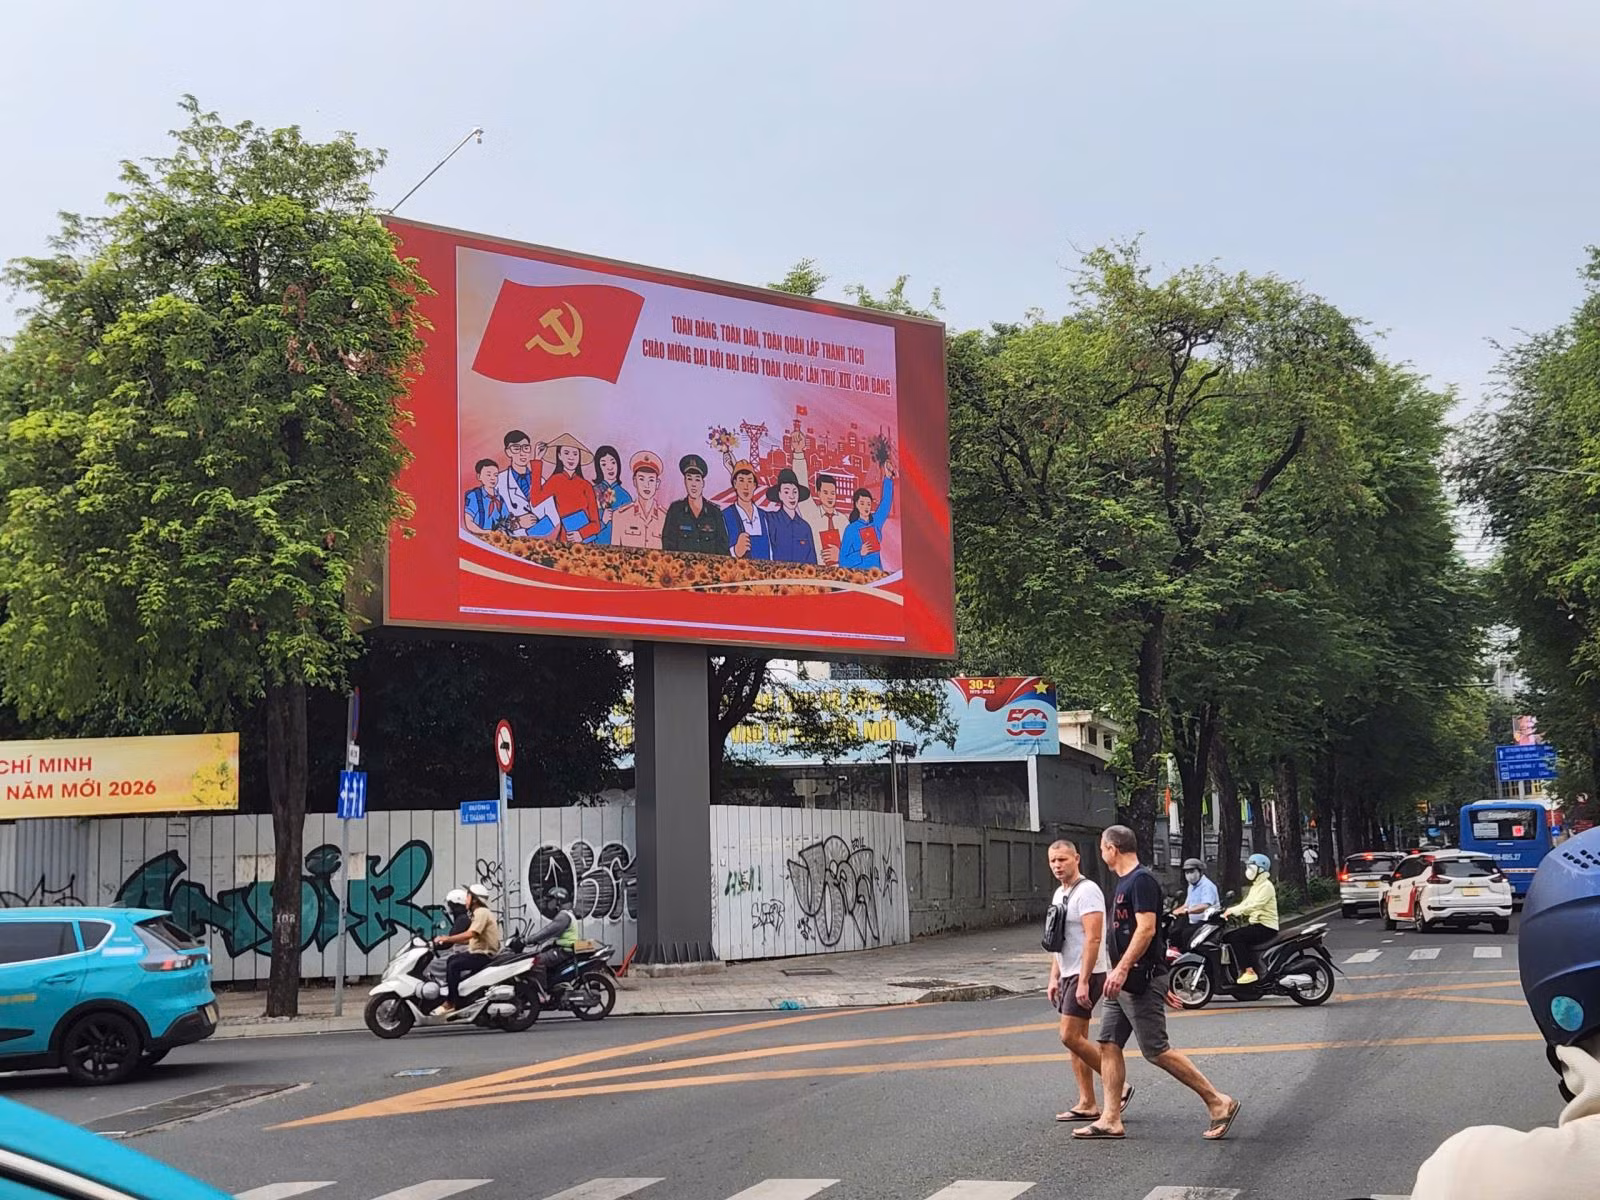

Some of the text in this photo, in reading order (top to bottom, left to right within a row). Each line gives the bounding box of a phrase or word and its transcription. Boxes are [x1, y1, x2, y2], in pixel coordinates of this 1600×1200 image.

[672, 314, 864, 365] TOÀN ĐẢNG, TOÀN DÂN, TOÀN QUÂN LẬP THÀNH TÍCH
[642, 338, 664, 360] CHÀO
[667, 342, 691, 364] MỪNG
[693, 347, 707, 368] ĐẠI
[710, 348, 724, 372] HỘI
[726, 352, 739, 374] ĐẠI
[742, 351, 759, 374] BIỂU
[761, 358, 781, 378] TOÀN
[783, 358, 803, 382] QUỐC
[806, 362, 819, 385] LẦN
[821, 368, 836, 387] THỨ
[855, 372, 870, 392] CỦA
[871, 374, 891, 395] ĐẢNG
[968, 679, 995, 690] 30-4
[39, 757, 92, 773] MINH
[6, 778, 156, 800] NĂM MỚI 2026
